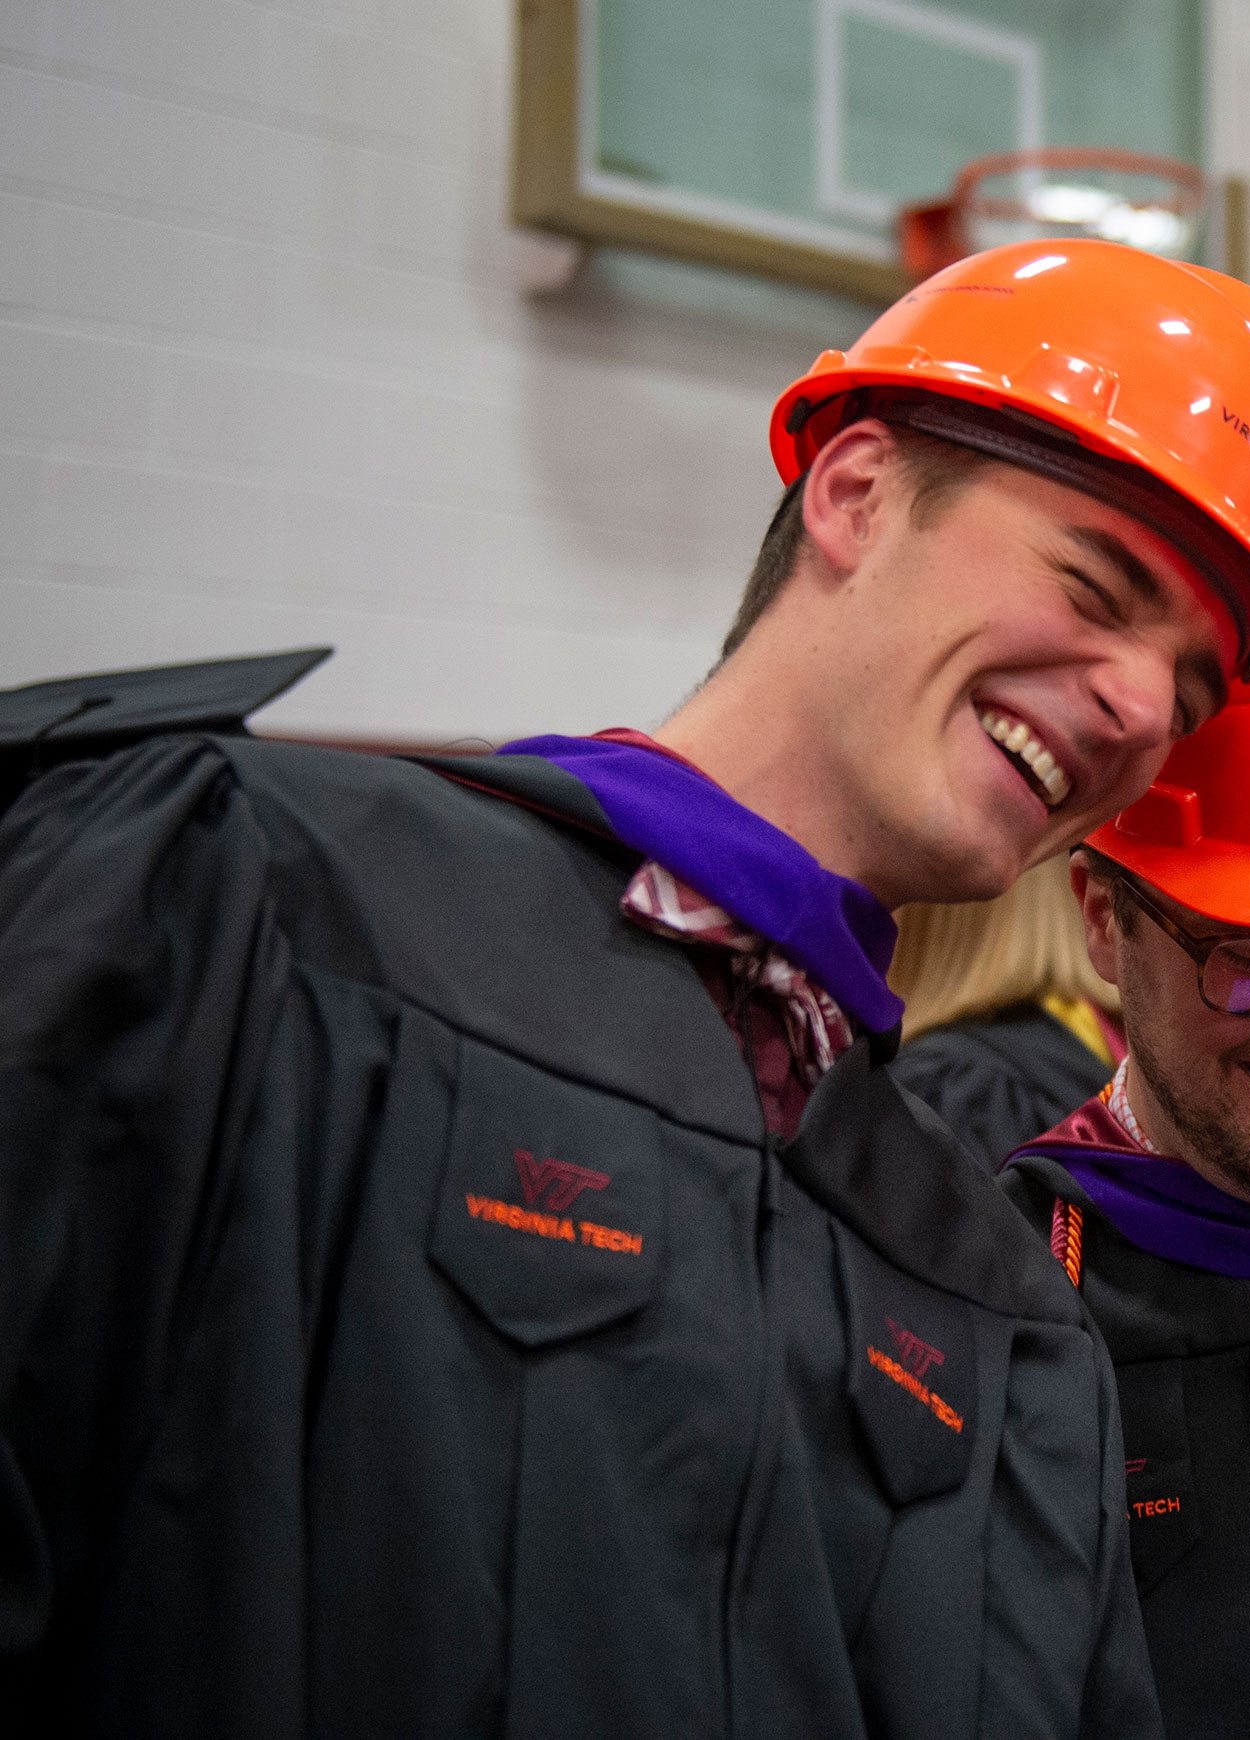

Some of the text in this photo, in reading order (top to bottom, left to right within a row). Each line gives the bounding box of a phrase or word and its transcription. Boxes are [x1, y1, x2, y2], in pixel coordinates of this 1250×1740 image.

[514, 1148, 610, 1211] VT
[466, 1192, 642, 1255] VIRGINIA TECH
[930, 1393, 963, 1434] TECH
[1133, 1497, 1180, 1519] TECH
